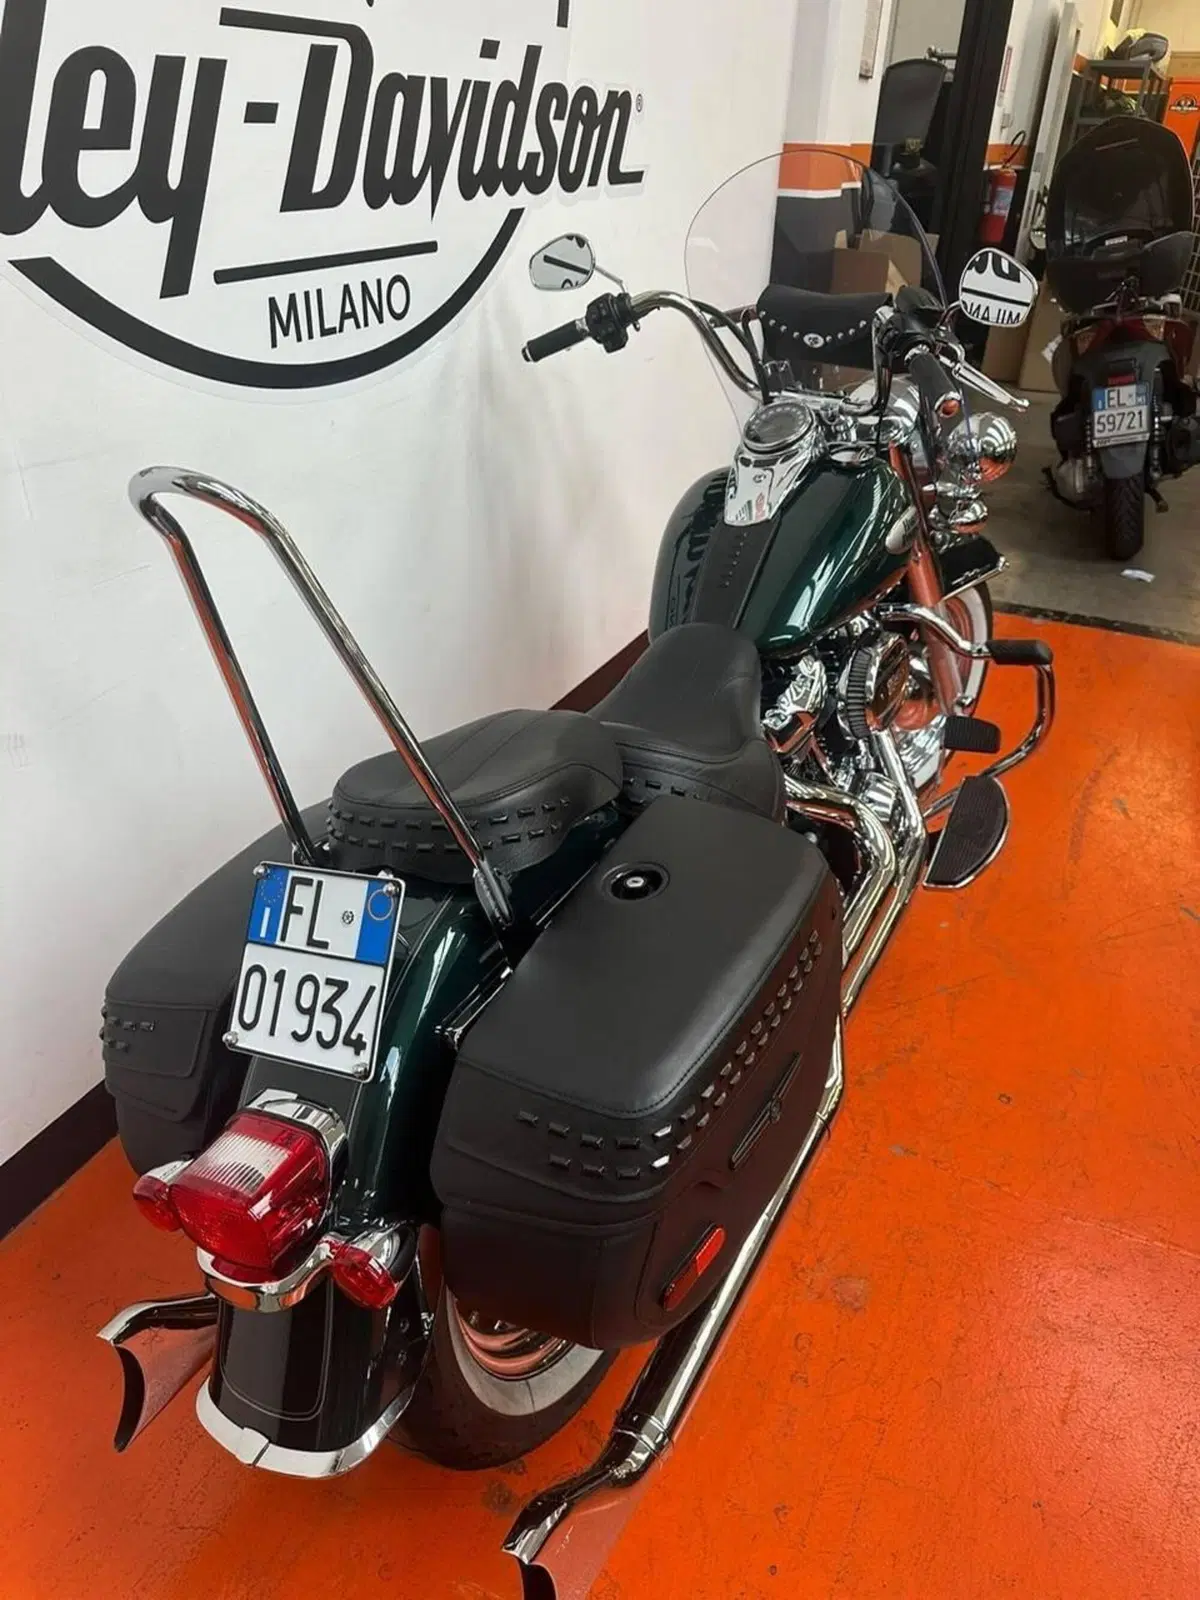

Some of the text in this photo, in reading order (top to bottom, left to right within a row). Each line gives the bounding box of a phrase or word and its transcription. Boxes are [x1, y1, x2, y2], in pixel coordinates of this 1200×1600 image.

[268, 274, 411, 349] MILANO
[1096, 410, 1143, 433] 59721
[1107, 389, 1127, 408] EL
[280, 875, 330, 950] FL
[238, 964, 376, 1056] 01934
